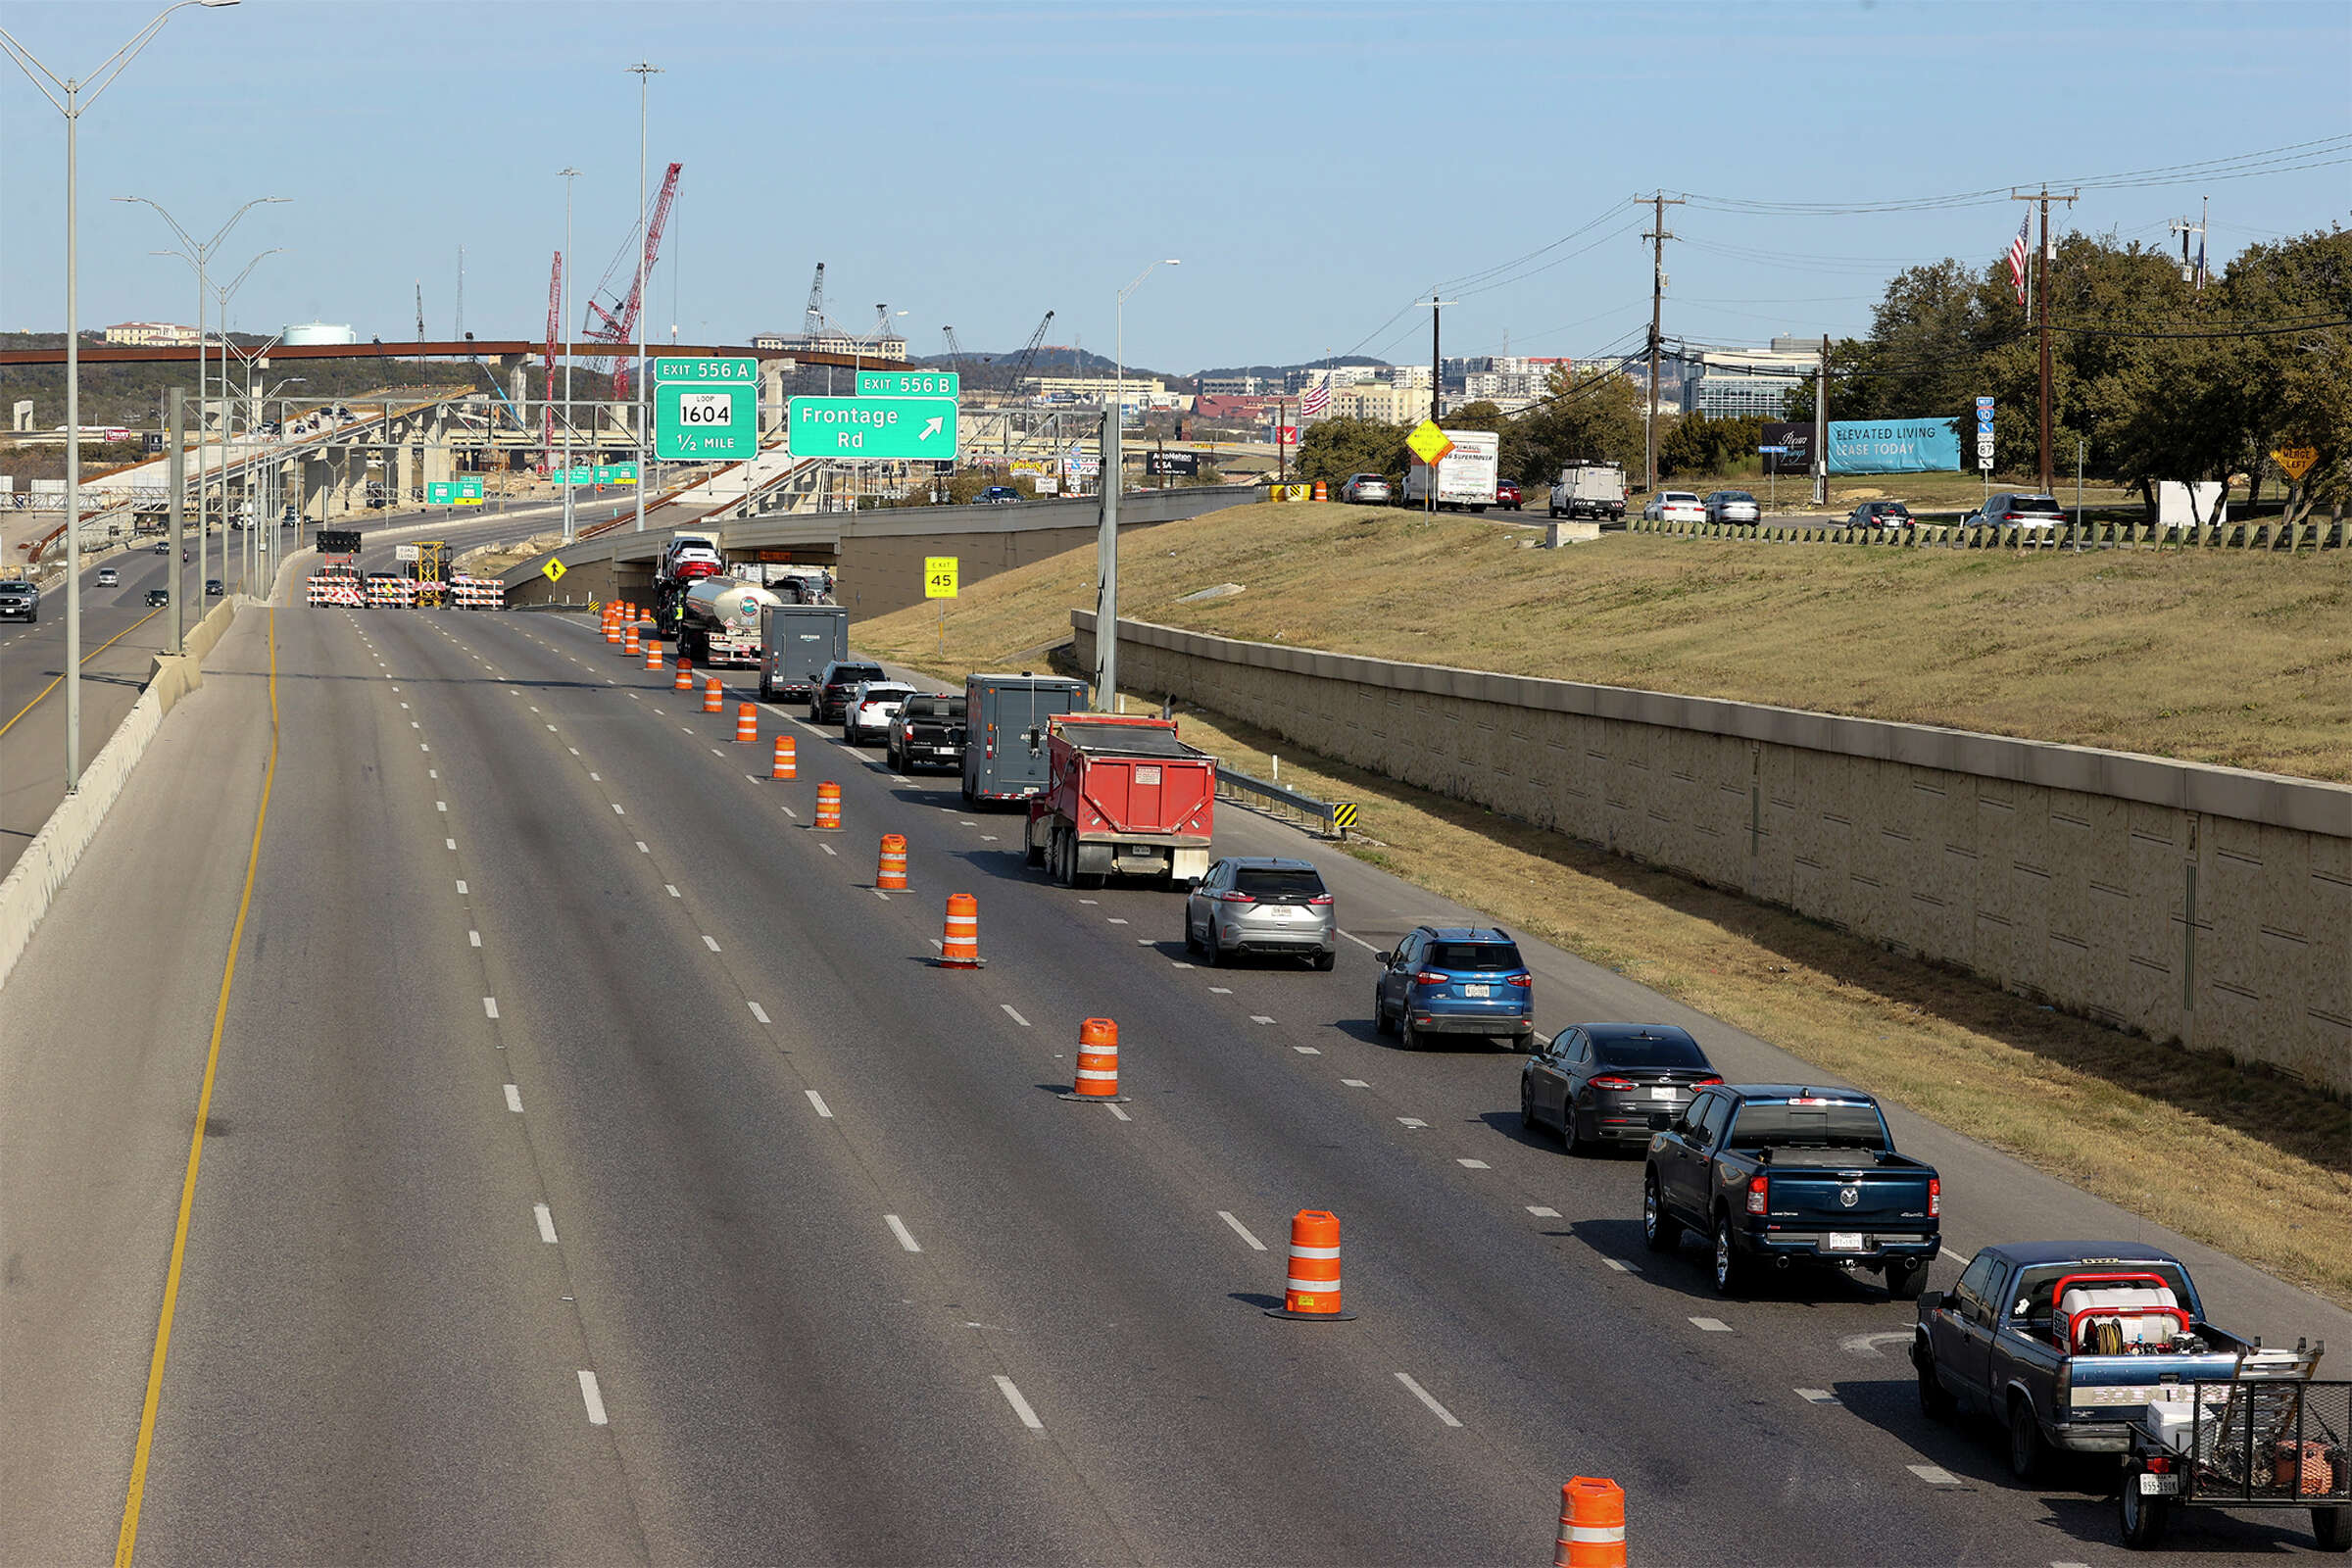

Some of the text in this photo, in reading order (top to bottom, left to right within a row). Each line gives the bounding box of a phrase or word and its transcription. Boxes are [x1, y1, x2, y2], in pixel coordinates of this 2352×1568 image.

[663, 364, 749, 377] EXIT 556 A
[863, 378, 951, 392] EXIT 556 B
[682, 406, 730, 423] 1604
[802, 407, 899, 426] Frontage
[837, 431, 863, 448] Rd
[1837, 427, 1936, 440] ELEVATED LIVING
[704, 438, 734, 448] MILE
[1836, 442, 1915, 456] LEASE TODAY
[1980, 445, 1992, 455] 87
[2282, 450, 2311, 460] MERGE
[1152, 453, 1192, 462] AutoNation
[931, 574, 951, 586] 45
